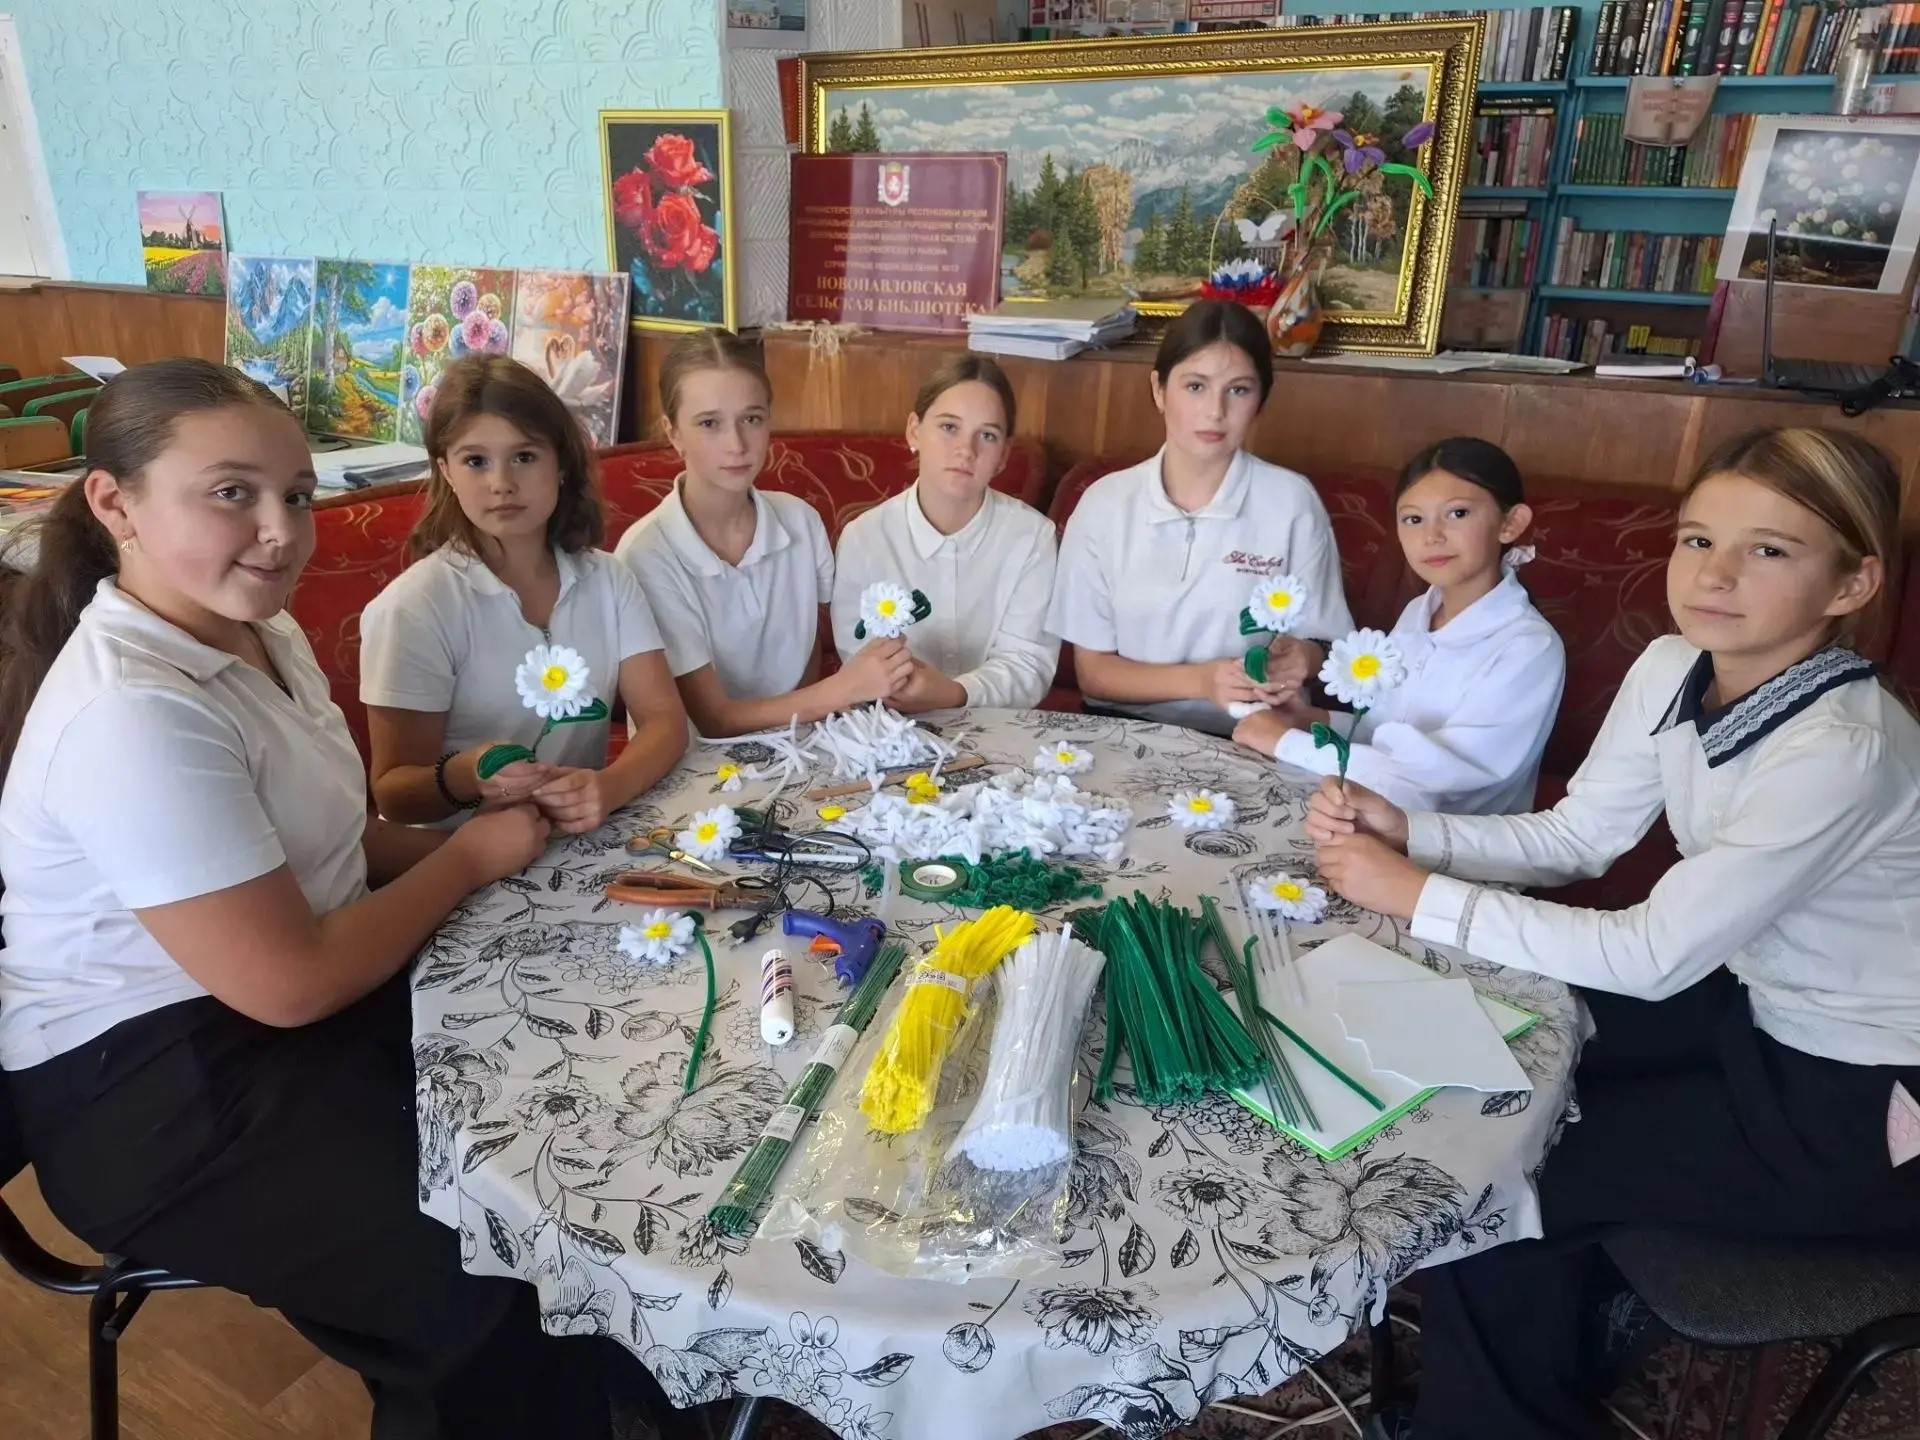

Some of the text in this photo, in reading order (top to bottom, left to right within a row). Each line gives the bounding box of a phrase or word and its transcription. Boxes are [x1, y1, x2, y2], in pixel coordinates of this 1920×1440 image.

[816, 276, 968, 296] НОВОПАВЛОВСКАЯ
[795, 294, 986, 316] СЕЛЬСКАЯ БИБЛИОТЕКА
